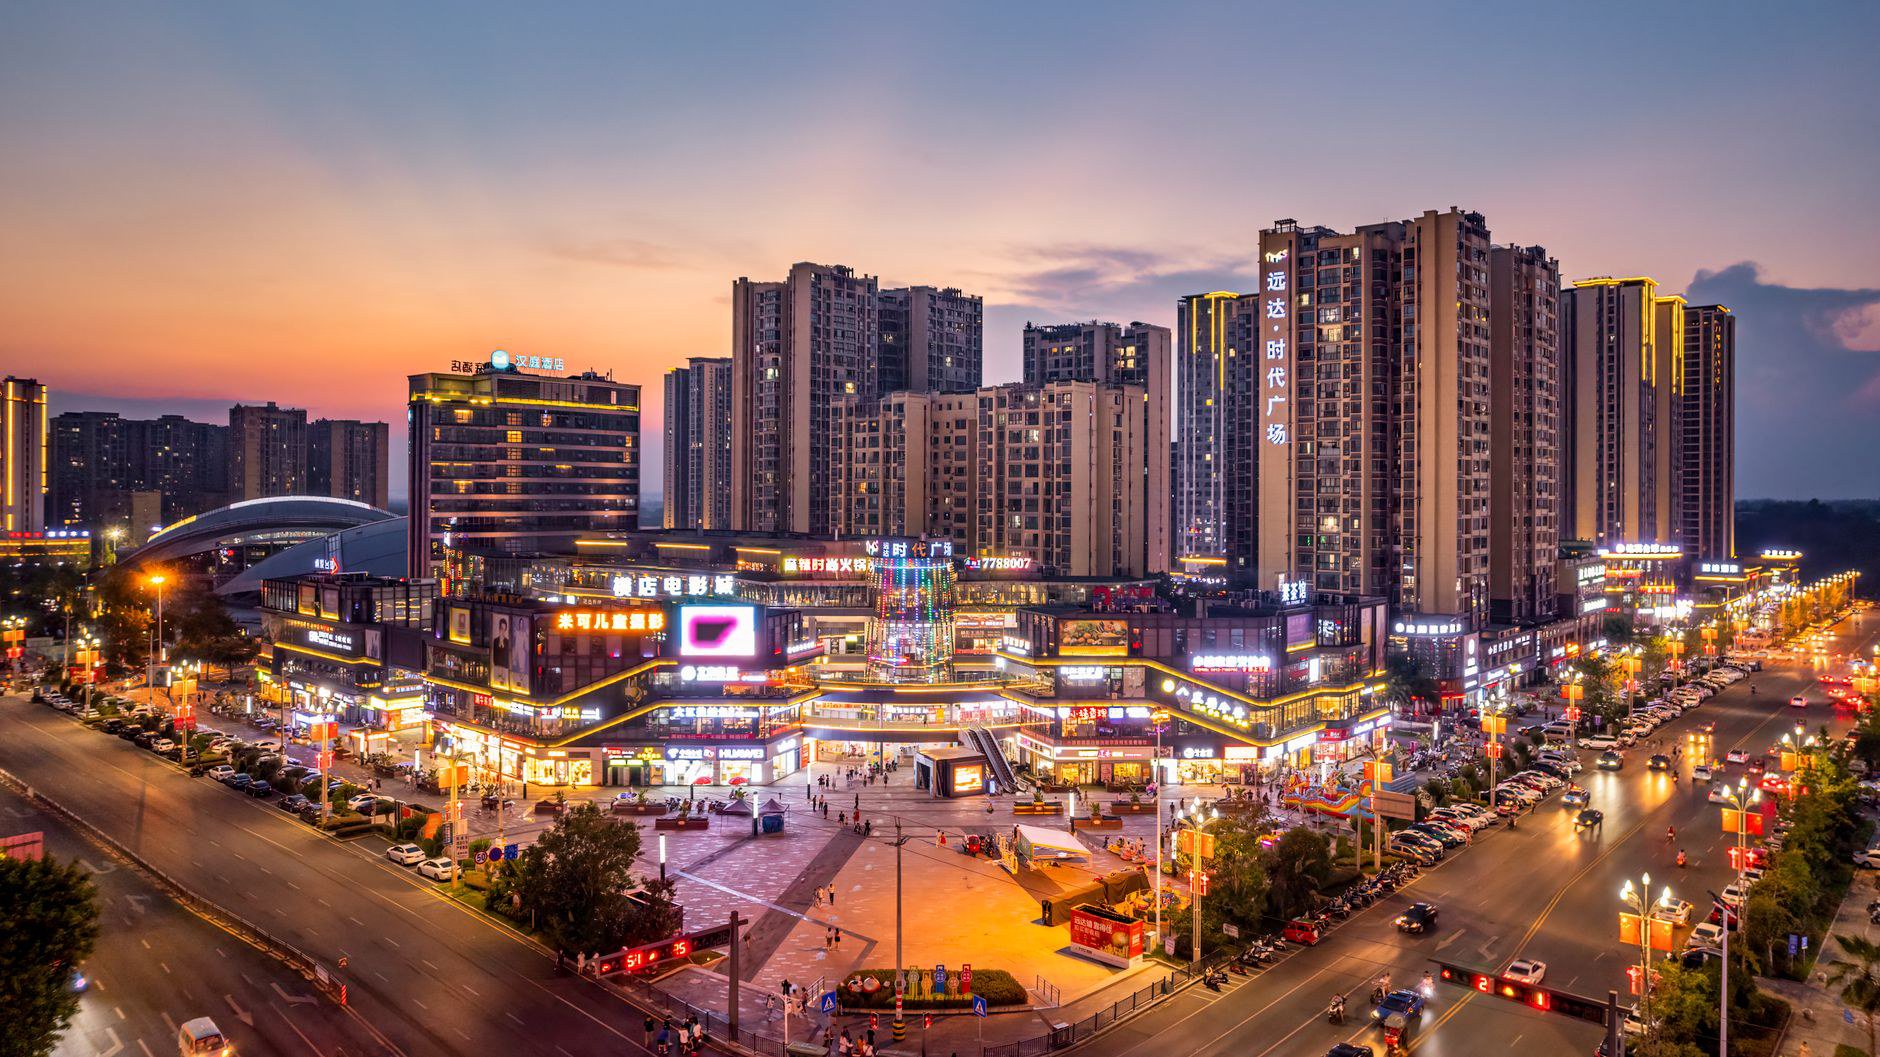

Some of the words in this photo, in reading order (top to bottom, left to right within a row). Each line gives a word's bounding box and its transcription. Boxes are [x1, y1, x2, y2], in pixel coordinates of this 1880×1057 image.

[515, 354, 564, 371] 汉庭酒店
[982, 557, 1031, 569] 7788007
[613, 575, 734, 597] 横店电影城
[1479, 977, 1488, 991] 2
